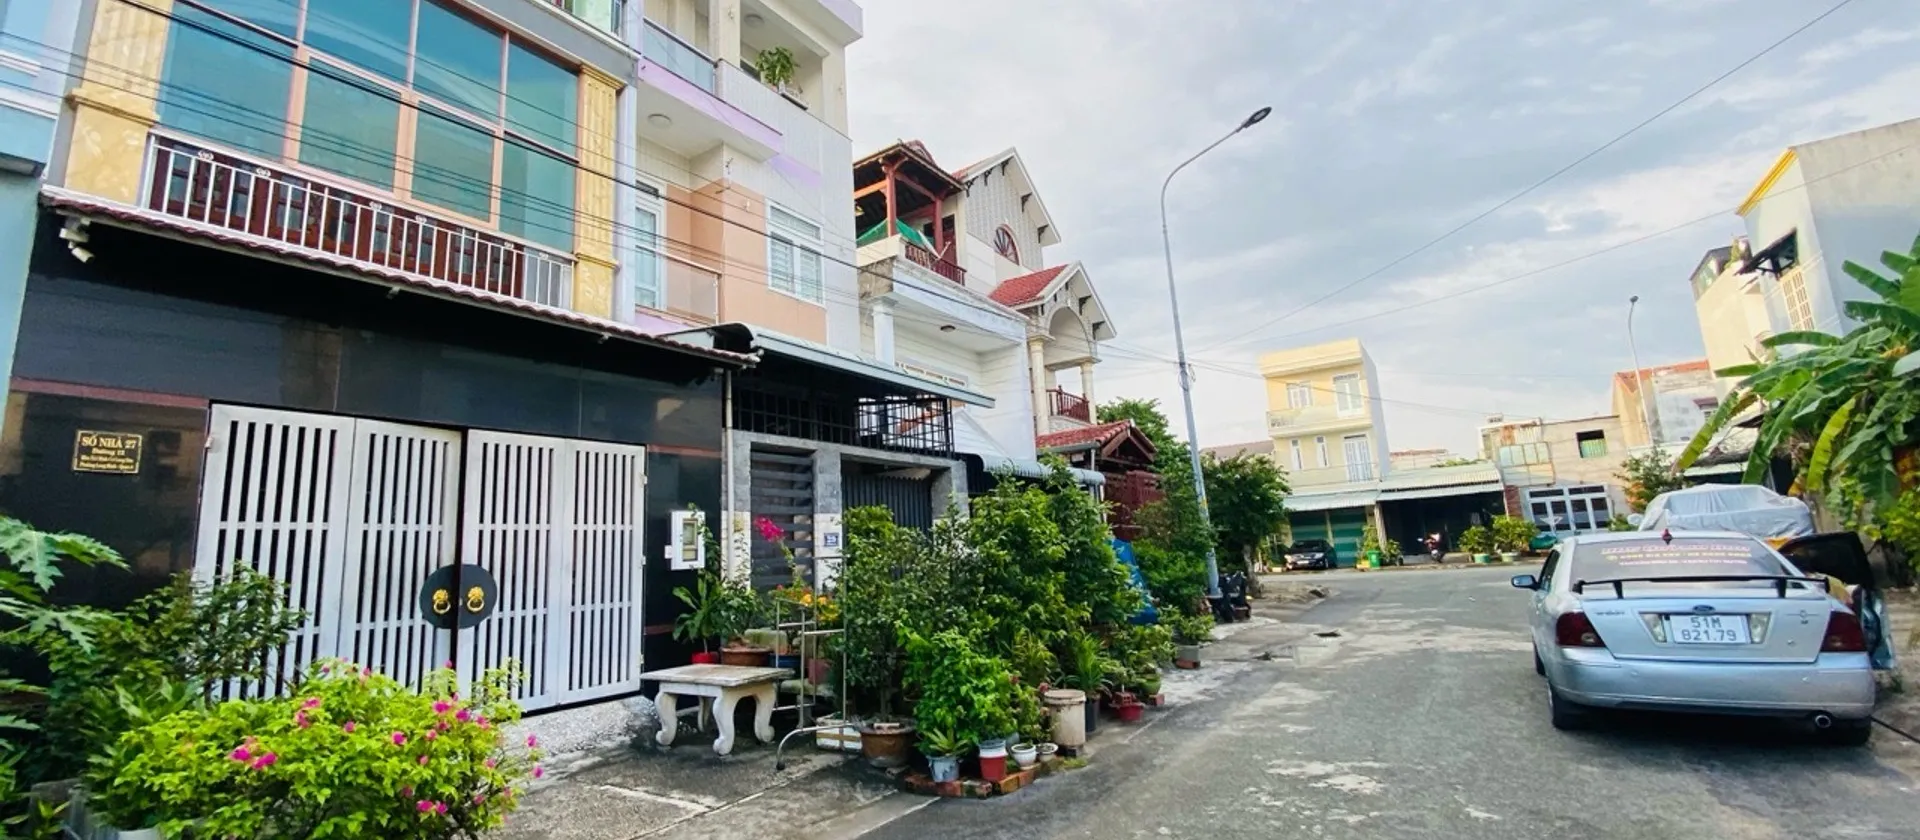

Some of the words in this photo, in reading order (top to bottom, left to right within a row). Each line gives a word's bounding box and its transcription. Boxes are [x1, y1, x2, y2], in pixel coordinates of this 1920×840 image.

[82, 434, 97, 447] SỐ
[99, 437, 122, 448] NHÀ
[124, 440, 137, 449] 27
[1690, 616, 1722, 628] 51M
[1681, 629, 1737, 641] 821.79
